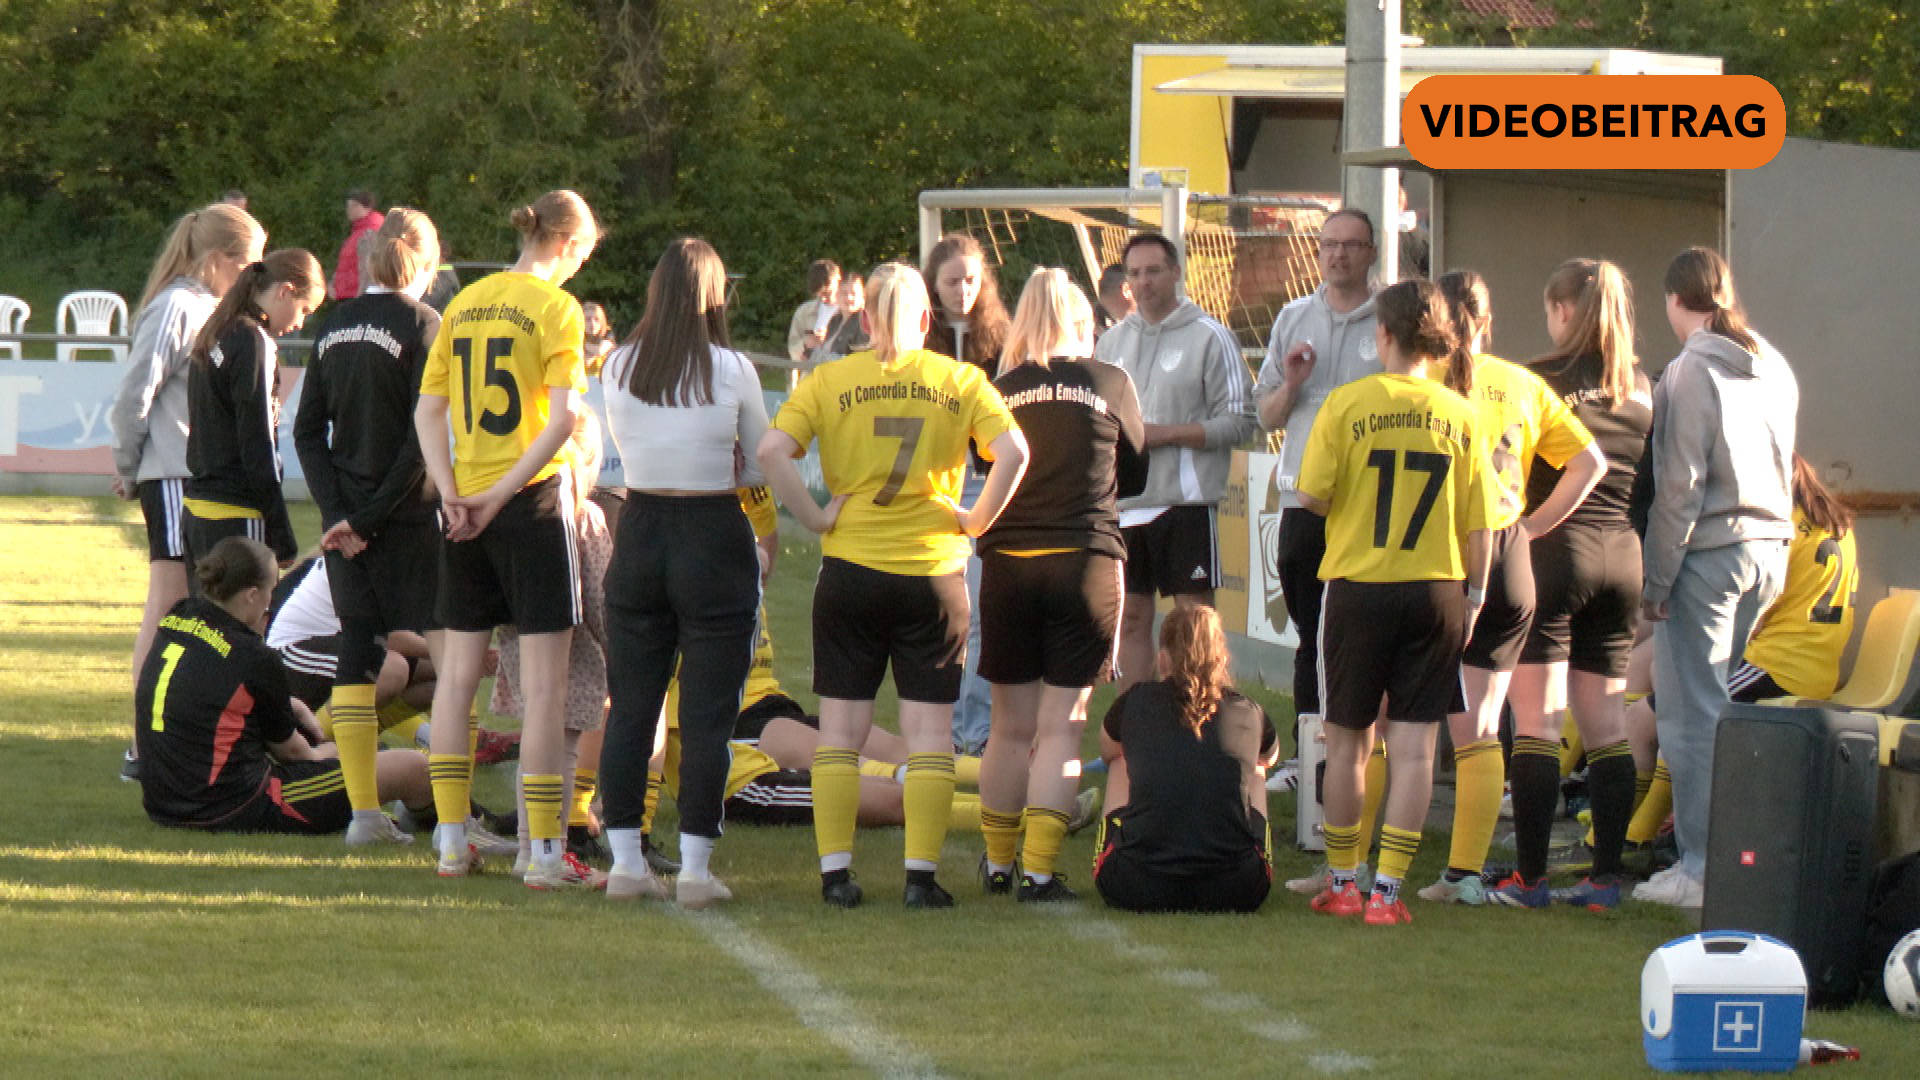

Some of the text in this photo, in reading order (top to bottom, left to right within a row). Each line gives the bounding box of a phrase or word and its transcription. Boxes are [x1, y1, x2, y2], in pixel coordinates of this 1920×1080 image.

[452, 337, 522, 437] 15
[839, 381, 960, 416] SV Concordia Emsbüren
[1352, 417, 1366, 441] SV
[1369, 409, 1422, 433] Concordia
[872, 415, 926, 507] 7
[1367, 448, 1453, 551] 17
[150, 641, 186, 733] 1
